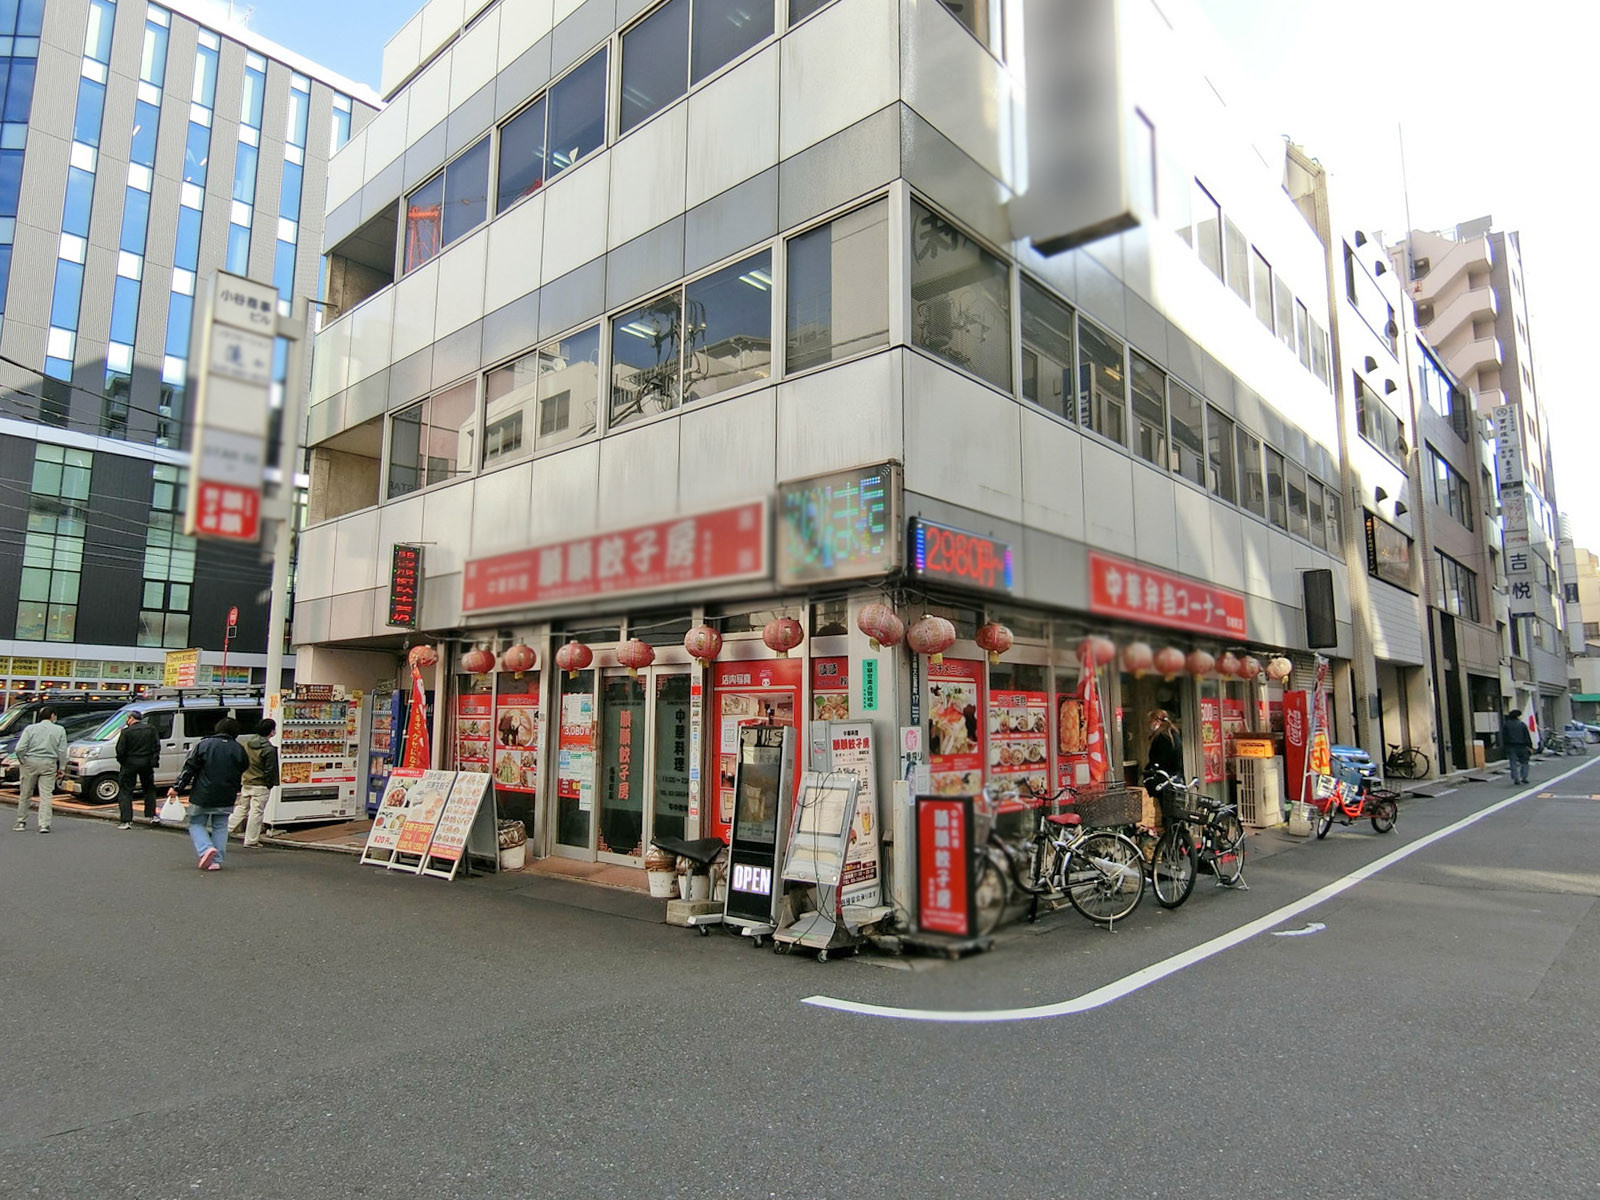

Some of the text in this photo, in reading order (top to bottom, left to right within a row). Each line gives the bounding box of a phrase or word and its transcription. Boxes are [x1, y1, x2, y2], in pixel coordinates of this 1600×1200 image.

[250, 312, 271, 325] ビル
[1105, 566, 1226, 624] 中華弁当コーナー
[1510, 553, 1532, 600] 吉悦
[618, 710, 631, 800] 順順餃子房
[674, 708, 686, 771] 中華料理
[734, 865, 771, 893] OPEN
